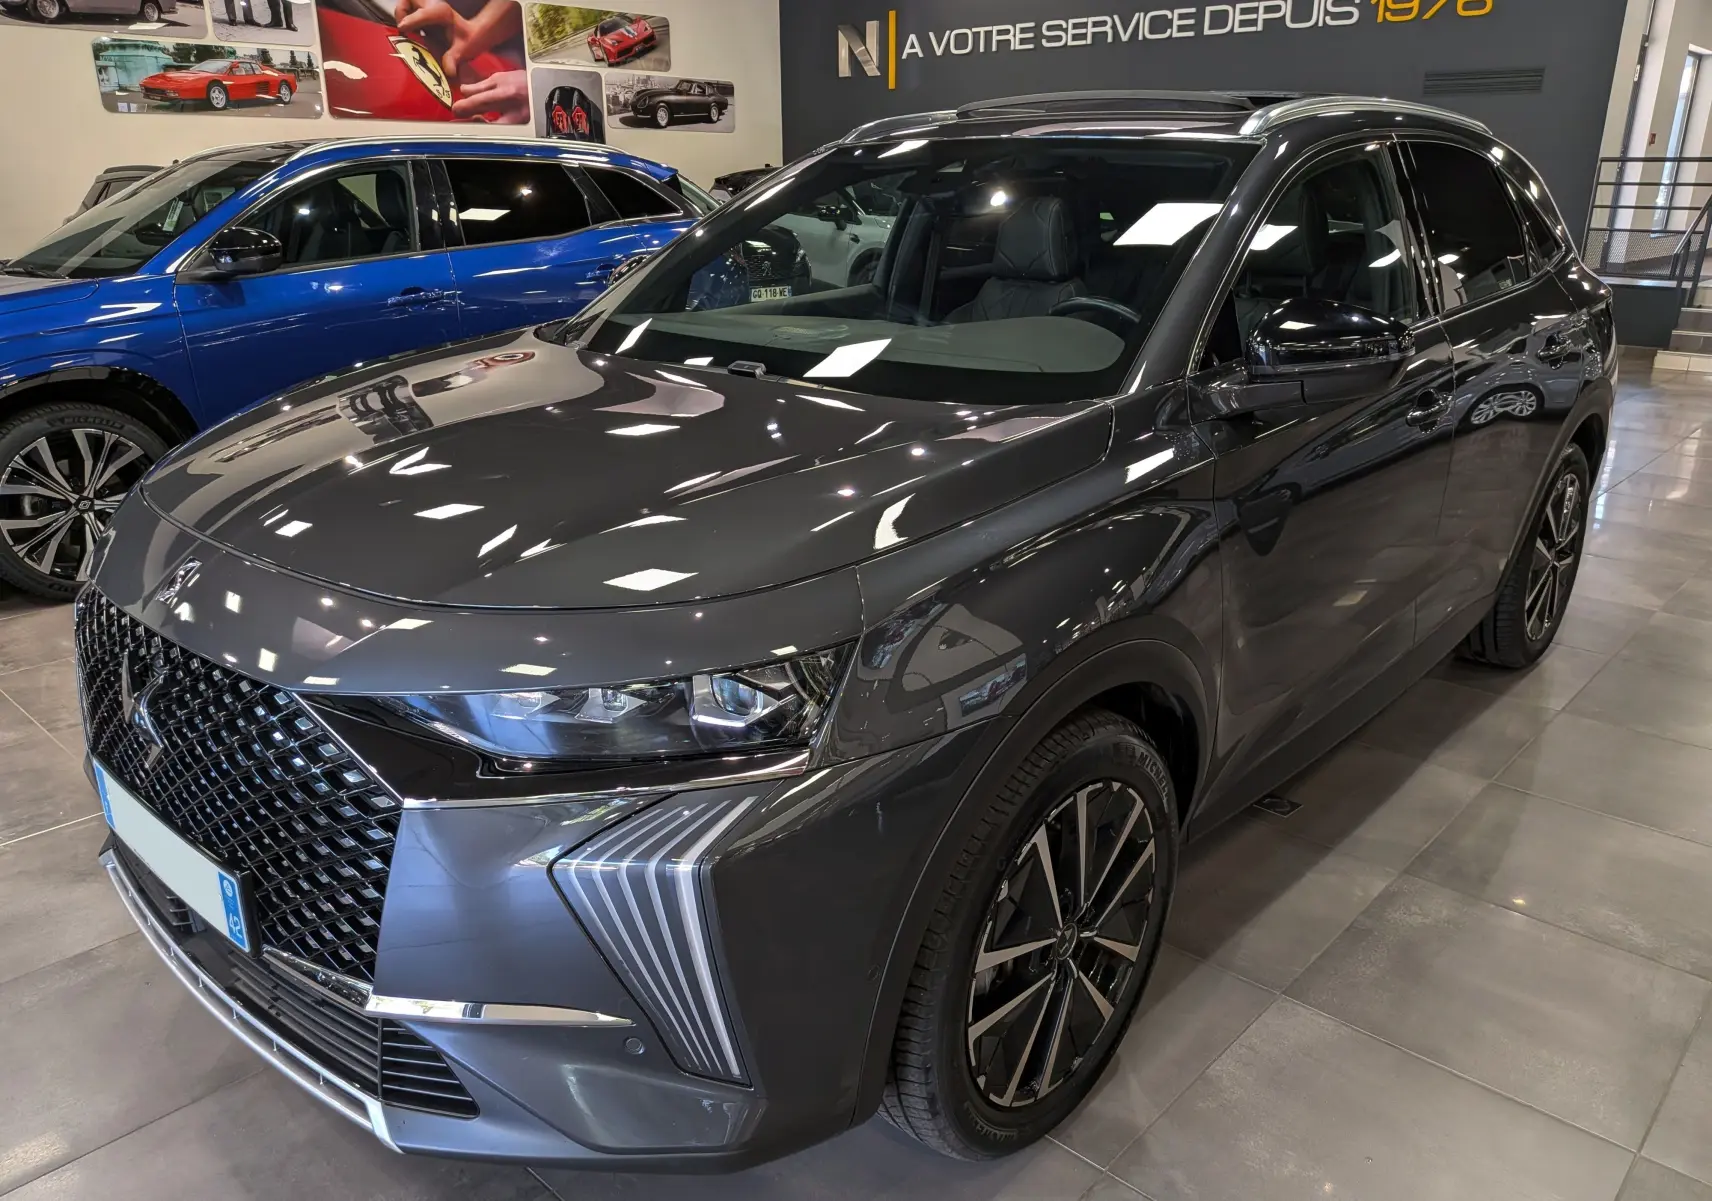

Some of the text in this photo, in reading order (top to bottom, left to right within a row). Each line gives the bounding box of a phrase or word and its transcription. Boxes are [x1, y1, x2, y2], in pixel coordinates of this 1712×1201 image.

[901, 33, 924, 60] A
[928, 22, 1036, 56] VOTRE
[1041, 7, 1197, 48] SERVICE
[1203, 0, 1360, 35] DEPUIS
